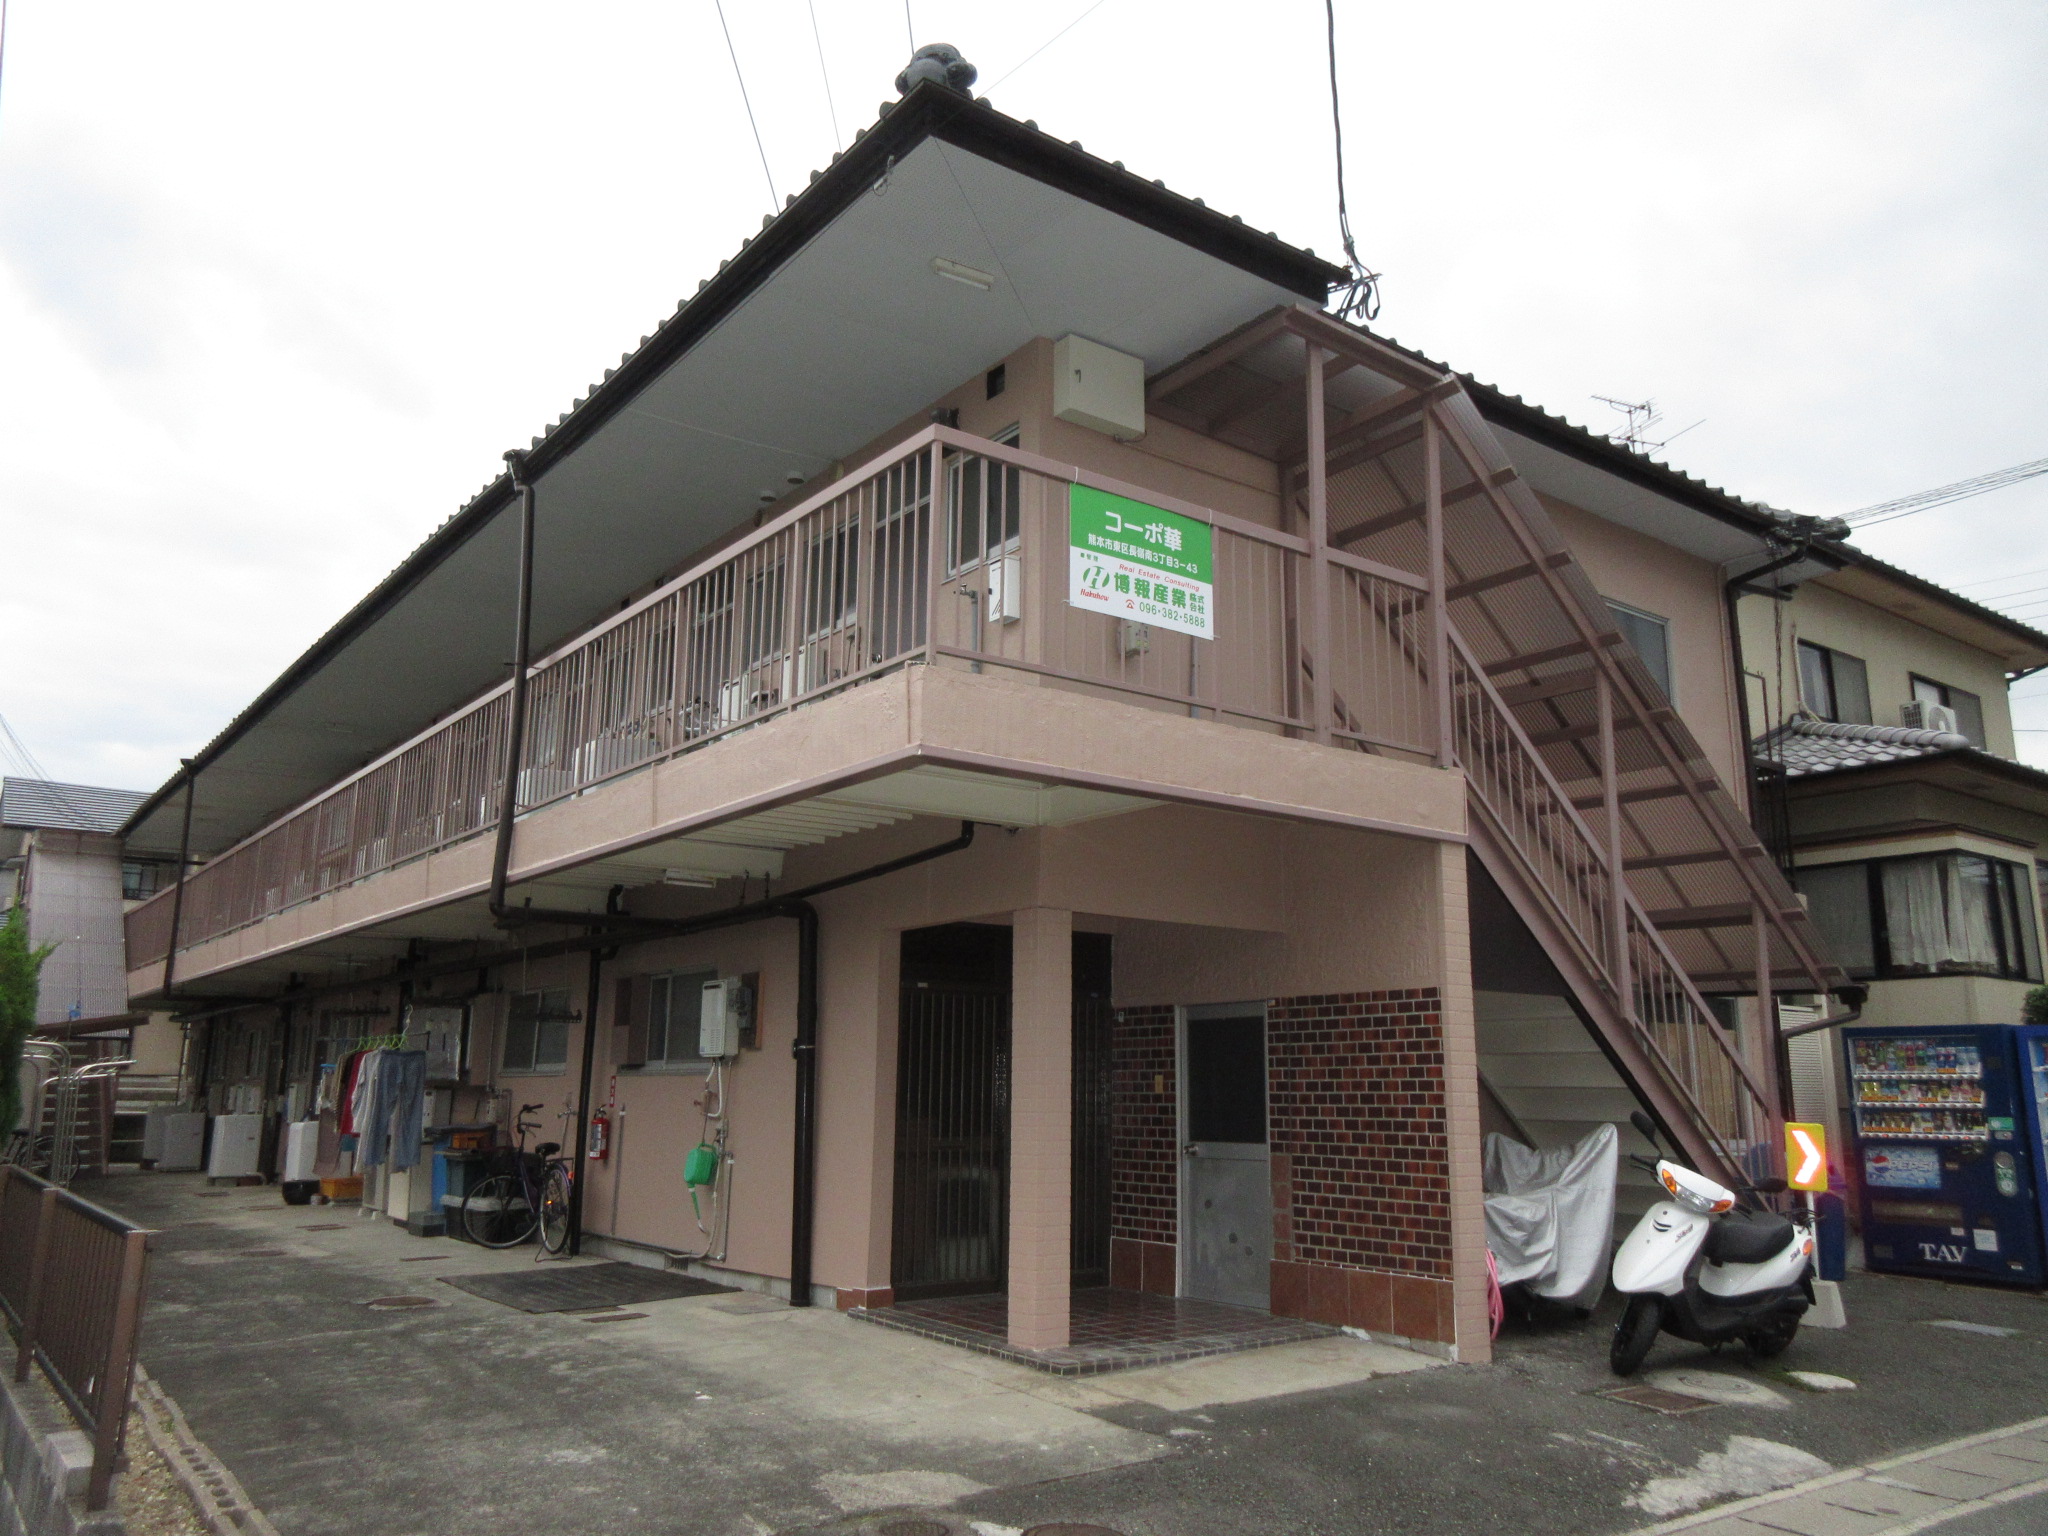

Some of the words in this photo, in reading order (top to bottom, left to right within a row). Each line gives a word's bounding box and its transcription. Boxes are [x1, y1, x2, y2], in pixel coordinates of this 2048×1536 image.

[1105, 511, 1182, 552] コーポ華
[1119, 563, 1135, 573] Real
[1138, 568, 1160, 581] Estate
[1164, 576, 1200, 592] Consulting
